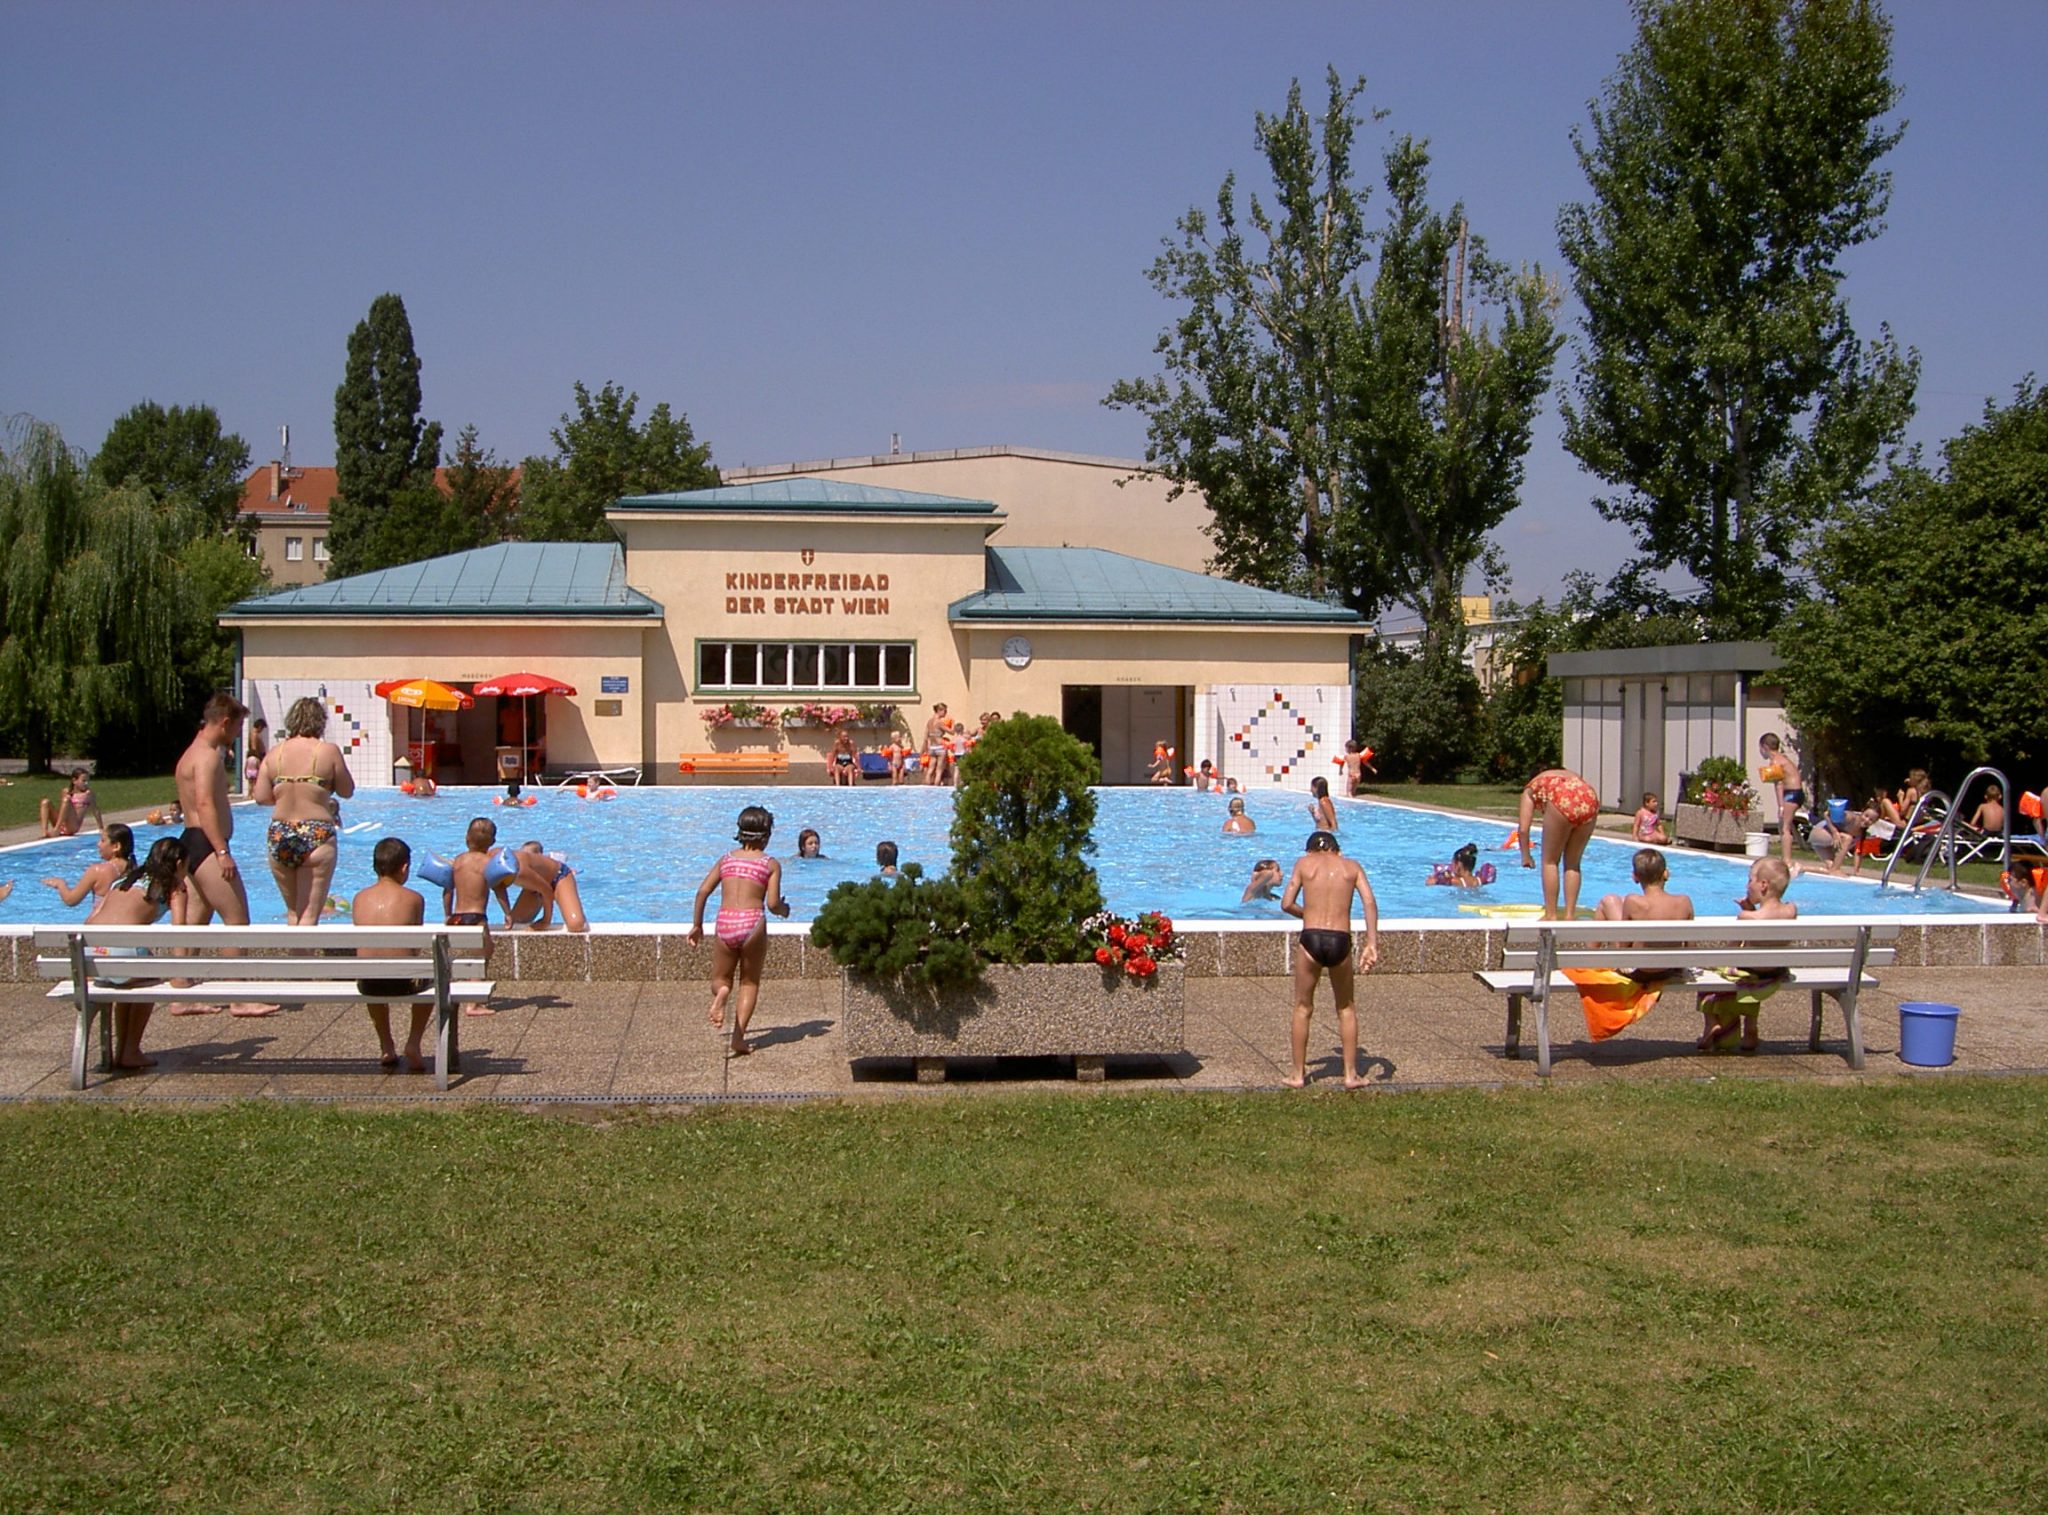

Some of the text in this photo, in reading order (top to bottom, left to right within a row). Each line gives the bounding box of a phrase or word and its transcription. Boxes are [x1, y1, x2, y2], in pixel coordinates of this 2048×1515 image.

[725, 572, 889, 591] KINDERFREIBAD
[725, 597, 889, 615] DER STADT WIEN
